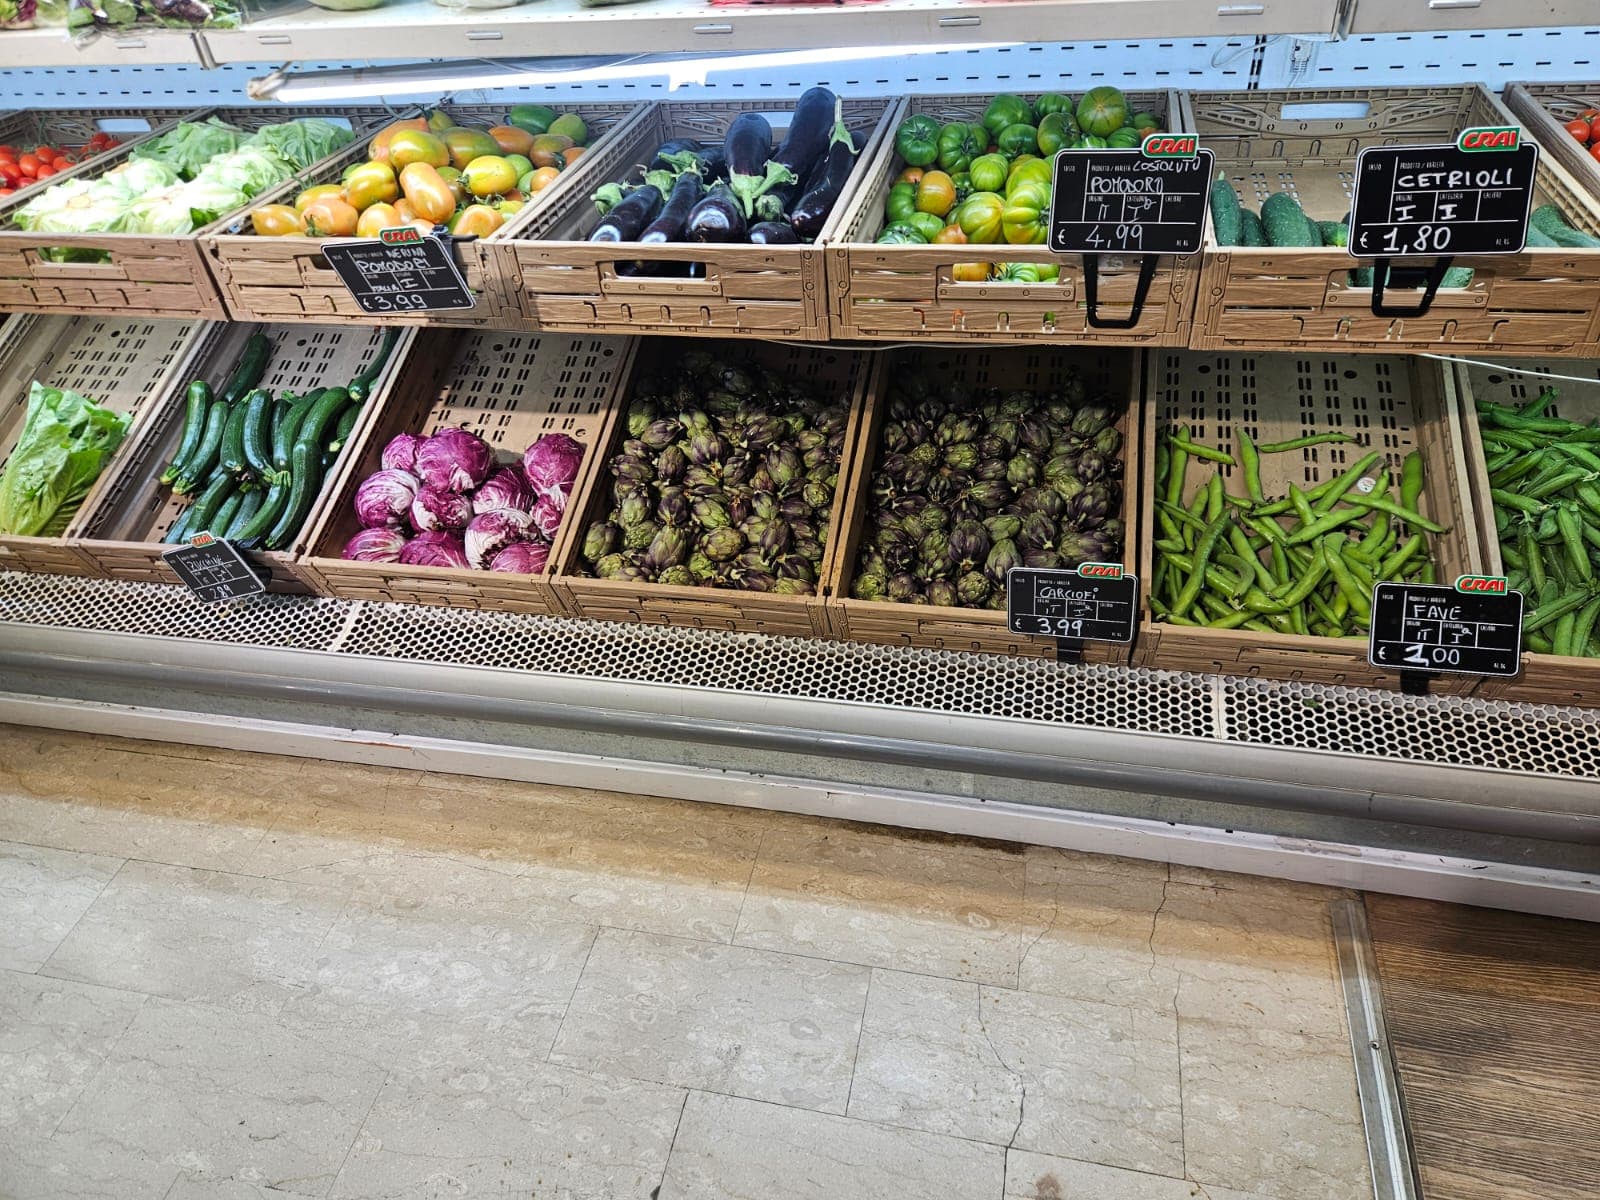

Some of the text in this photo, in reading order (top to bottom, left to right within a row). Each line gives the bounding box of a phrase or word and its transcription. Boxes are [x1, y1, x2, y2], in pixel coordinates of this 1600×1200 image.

[1147, 138, 1194, 153] CRAI
[1463, 131, 1517, 148] CRAI
[1091, 176, 1164, 195] POMODORI
[1398, 168, 1513, 188] CETRIOLI
[383, 230, 419, 243] CRAI
[1057, 224, 1143, 250] € 4,99
[1359, 225, 1451, 254] € 1,80
[374, 294, 428, 311] 3,99
[1081, 565, 1120, 577] CRAI
[1460, 578, 1504, 592] CRAI
[1413, 604, 1462, 620] FAVE
[1015, 618, 1083, 637] € 3,99
[1377, 646, 1387, 660] €
